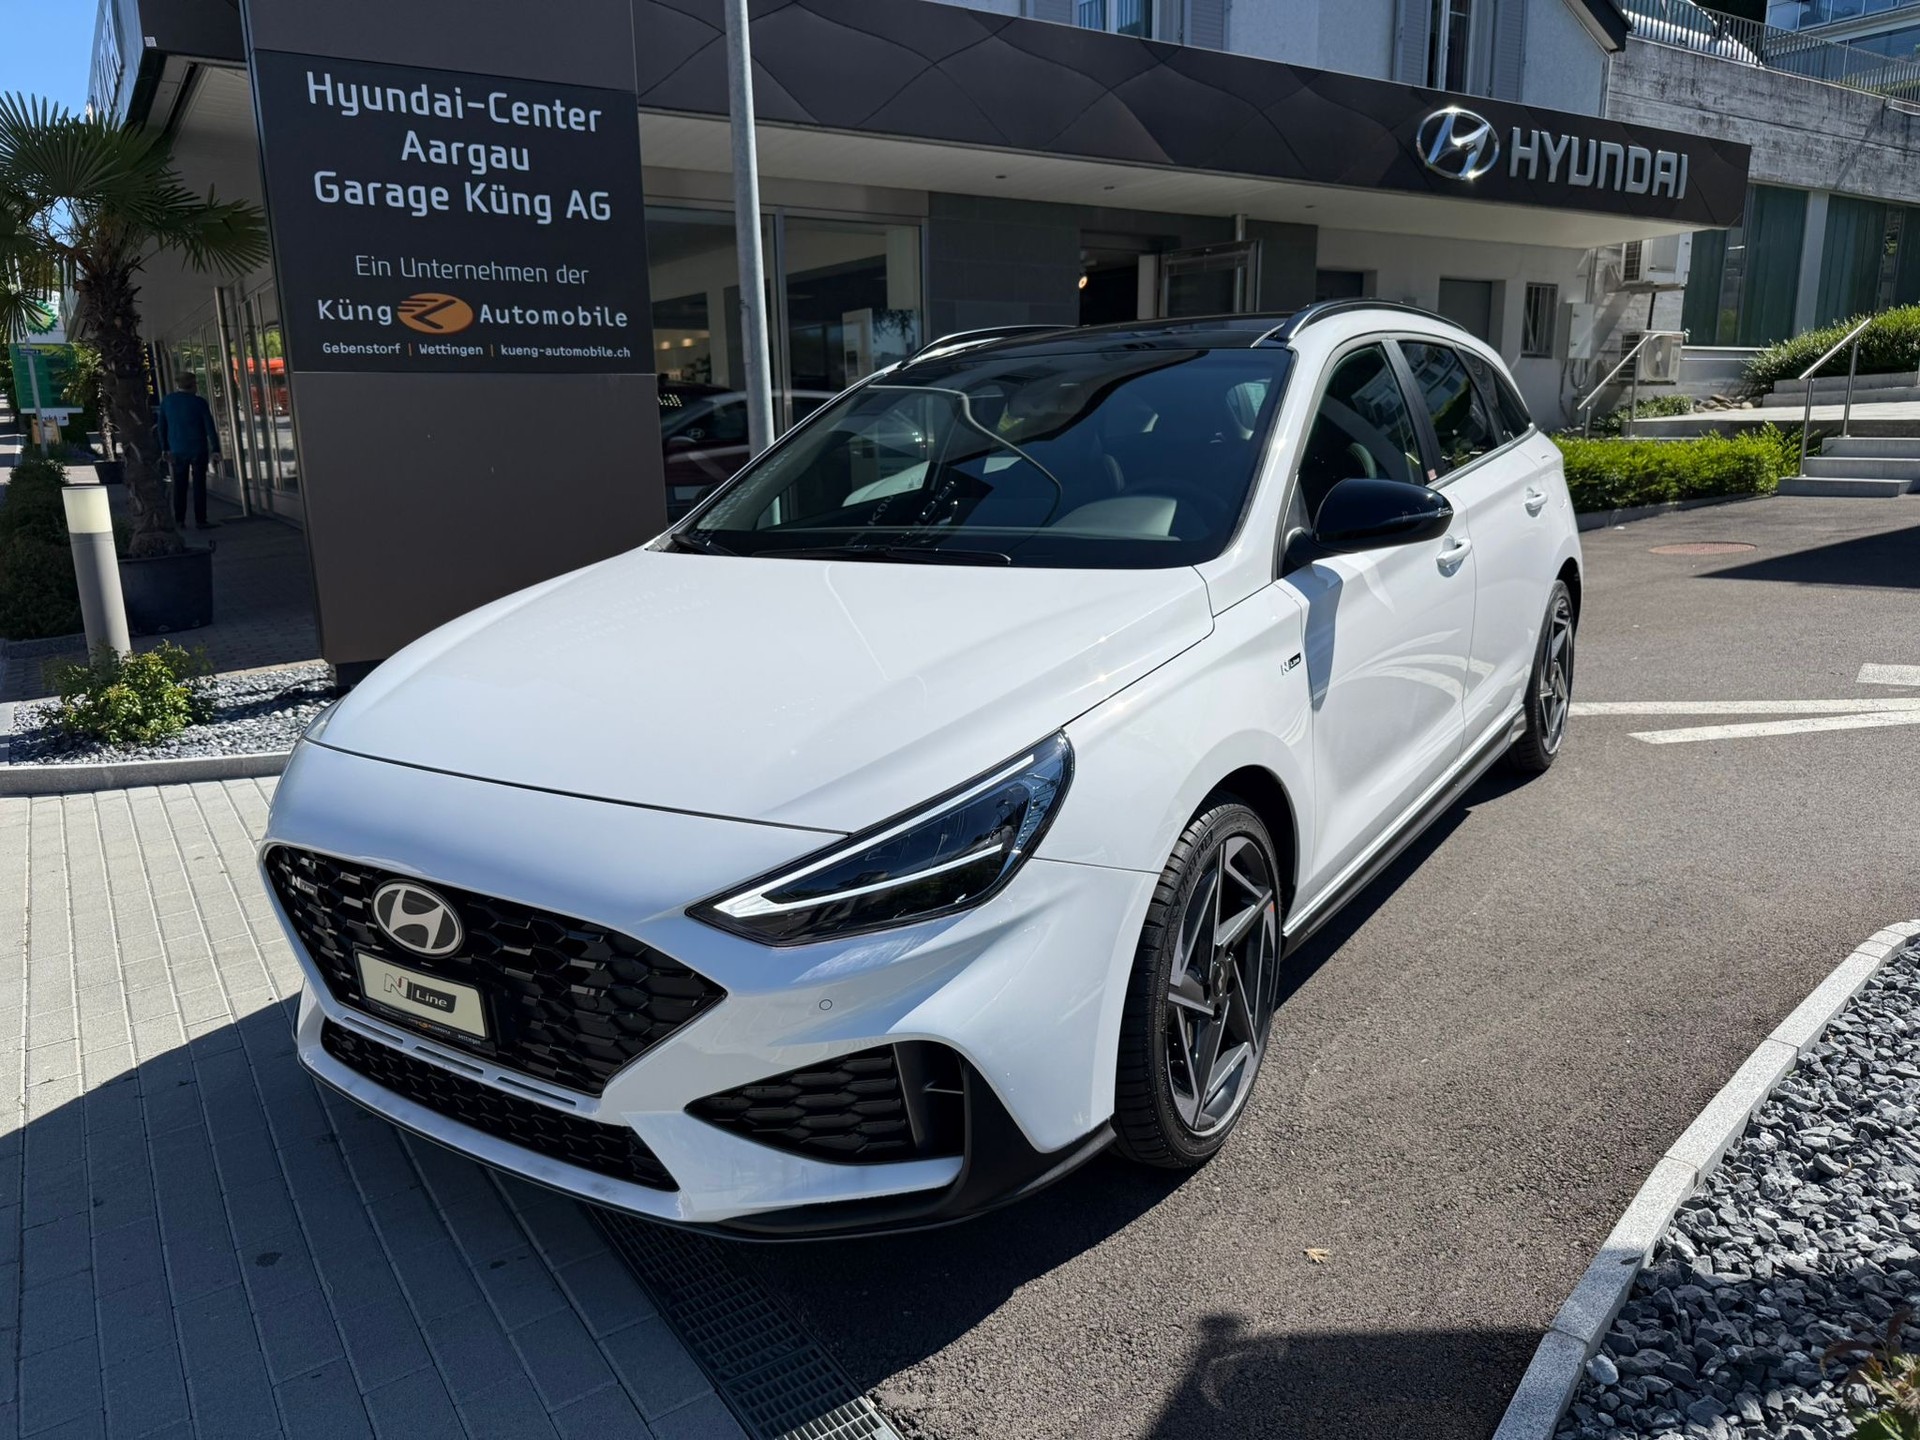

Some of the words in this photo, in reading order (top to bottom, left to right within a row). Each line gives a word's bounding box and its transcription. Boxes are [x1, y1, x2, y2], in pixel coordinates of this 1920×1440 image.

[307, 71, 602, 132] Hyundai-Center
[401, 130, 530, 175] Aargau
[1509, 126, 1689, 199] HYUNDAI
[313, 171, 450, 217] Garage
[464, 181, 552, 225] Küng
[565, 190, 612, 221] AG
[355, 255, 392, 277] Ein
[400, 257, 548, 283] Unternehmen
[556, 264, 589, 285] der
[317, 299, 392, 326] Küng
[480, 304, 628, 328] Automobile
[322, 342, 401, 355] Gebenstorf
[419, 343, 484, 357] Wettingen
[500, 344, 631, 358] kueng-automobile.ch
[384, 973, 409, 1000] N
[415, 989, 448, 1007] Line
